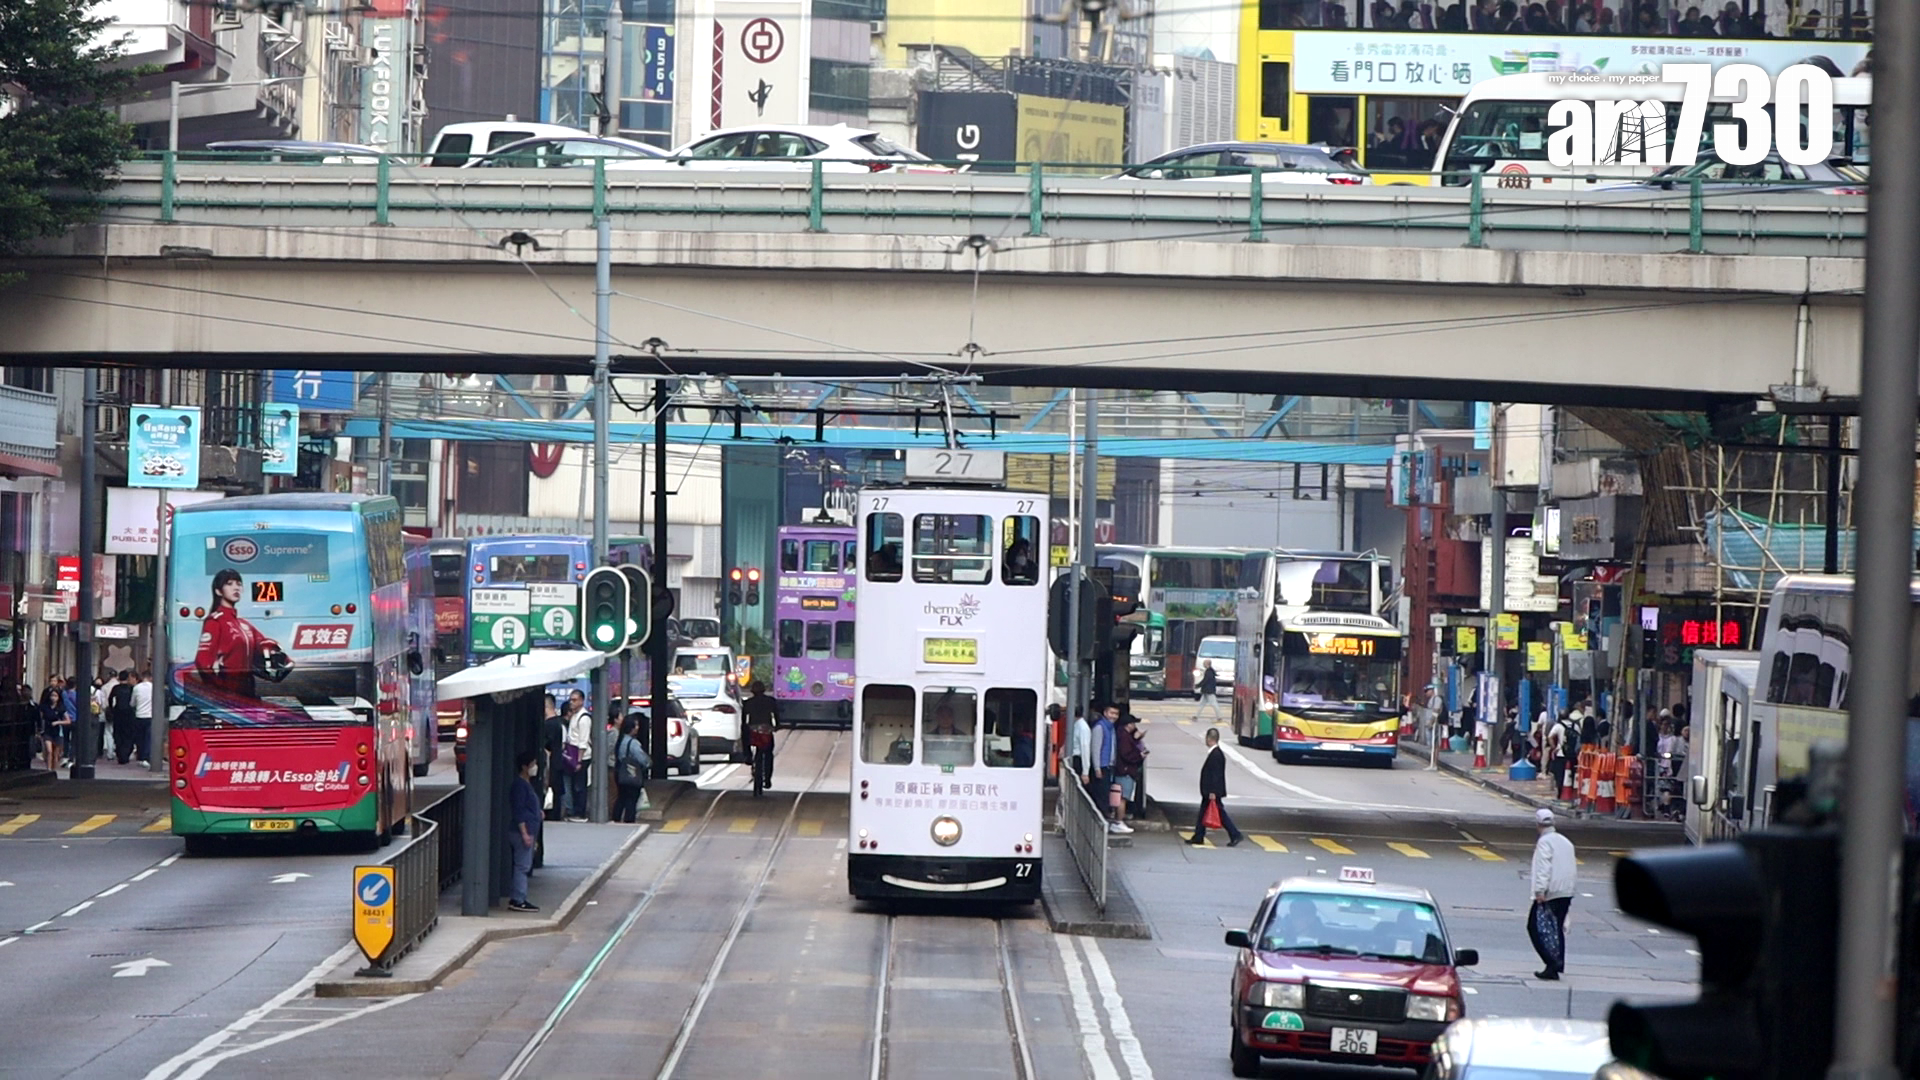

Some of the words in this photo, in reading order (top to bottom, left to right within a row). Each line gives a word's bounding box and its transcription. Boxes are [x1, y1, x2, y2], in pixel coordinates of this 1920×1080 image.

[370, 24, 392, 125] LUKFOOK
[656, 38, 666, 96] 9564
[1330, 60, 1397, 83] 看門口
[747, 77, 774, 117] 中
[293, 369, 322, 400] 行
[934, 452, 974, 475] 27
[872, 498, 889, 511] 27
[1017, 500, 1034, 513] 27
[111, 535, 147, 543] PUBLIC
[228, 543, 253, 555] Esso
[256, 581, 278, 602] 2A
[923, 601, 979, 619] thermage
[939, 615, 963, 626] FLX
[1360, 639, 1374, 656] 11
[894, 781, 944, 796] 原廠正貨
[949, 783, 999, 797] 無可取代
[255, 821, 267, 829] UF
[1015, 863, 1033, 878] 27
[1344, 869, 1373, 879] TAXI
[362, 909, 386, 917] 48431
[1345, 1029, 1364, 1041] EV
[1339, 1041, 1369, 1054] 206
